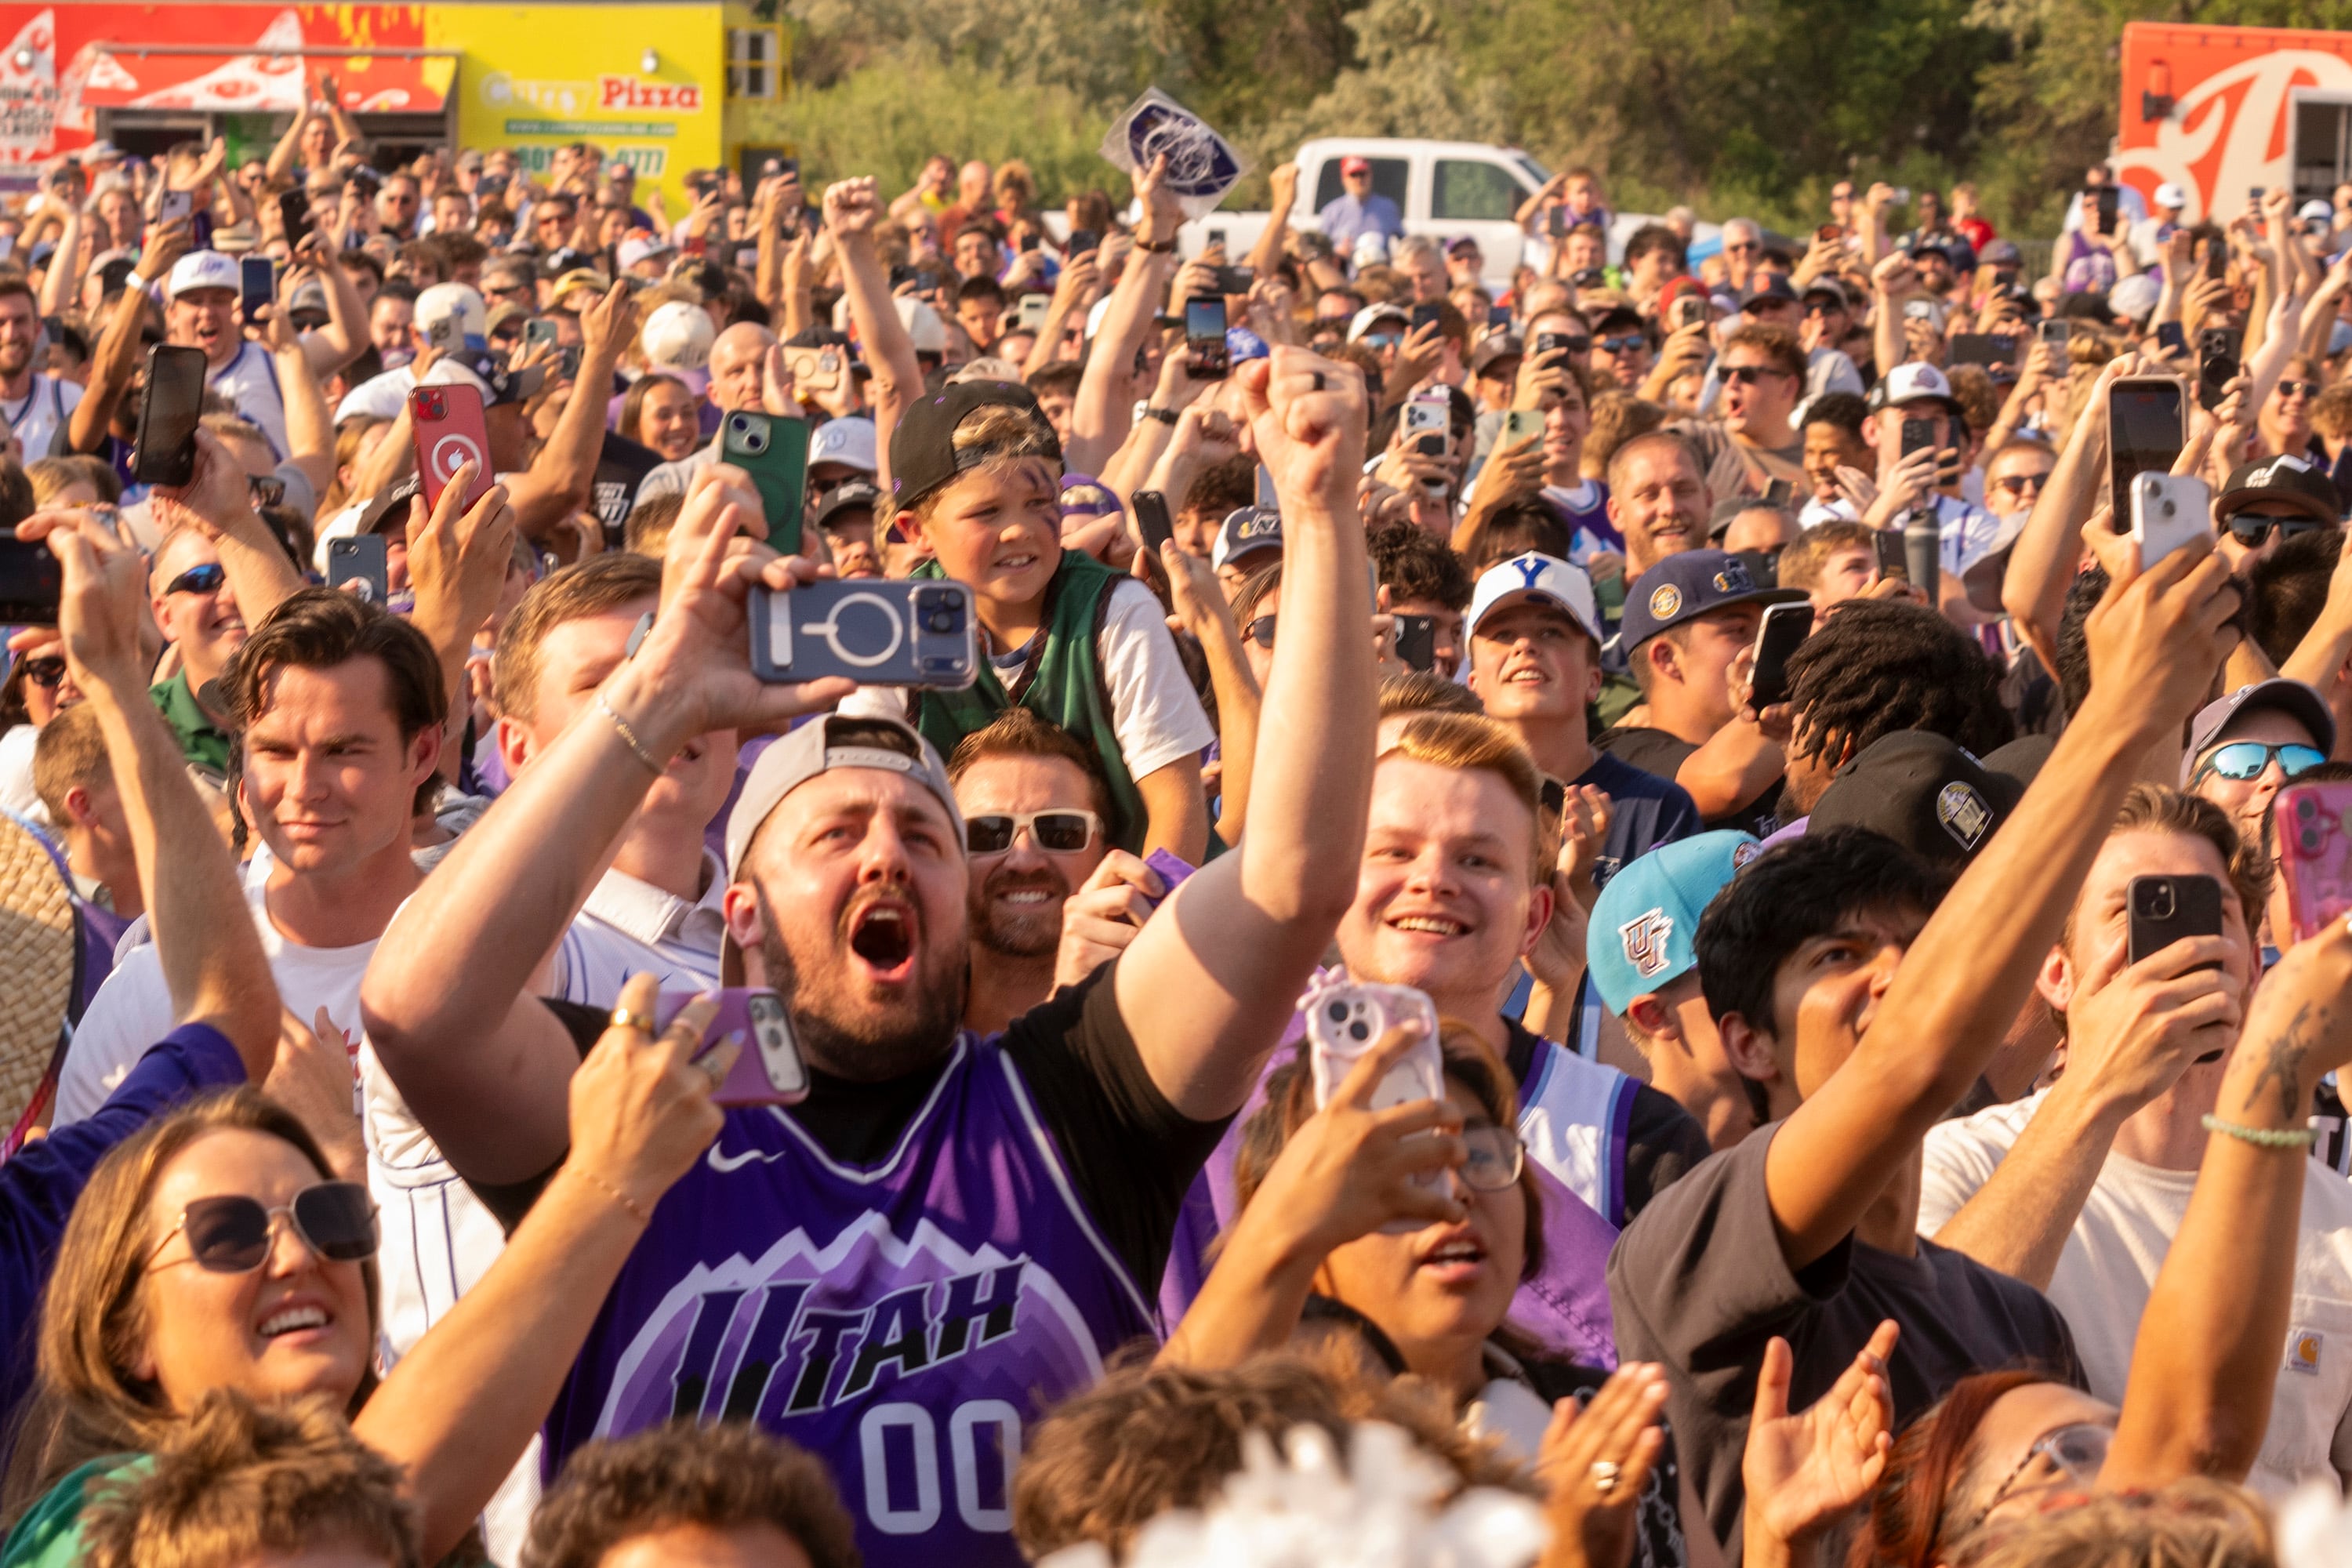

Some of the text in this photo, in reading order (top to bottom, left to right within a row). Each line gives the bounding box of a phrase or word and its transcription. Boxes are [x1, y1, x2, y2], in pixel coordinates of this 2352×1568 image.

[602, 78, 699, 108] Pizza
[1512, 557, 1551, 590] Y
[670, 1252, 1032, 1428] UTAH
[859, 1399, 1022, 1534] 00
